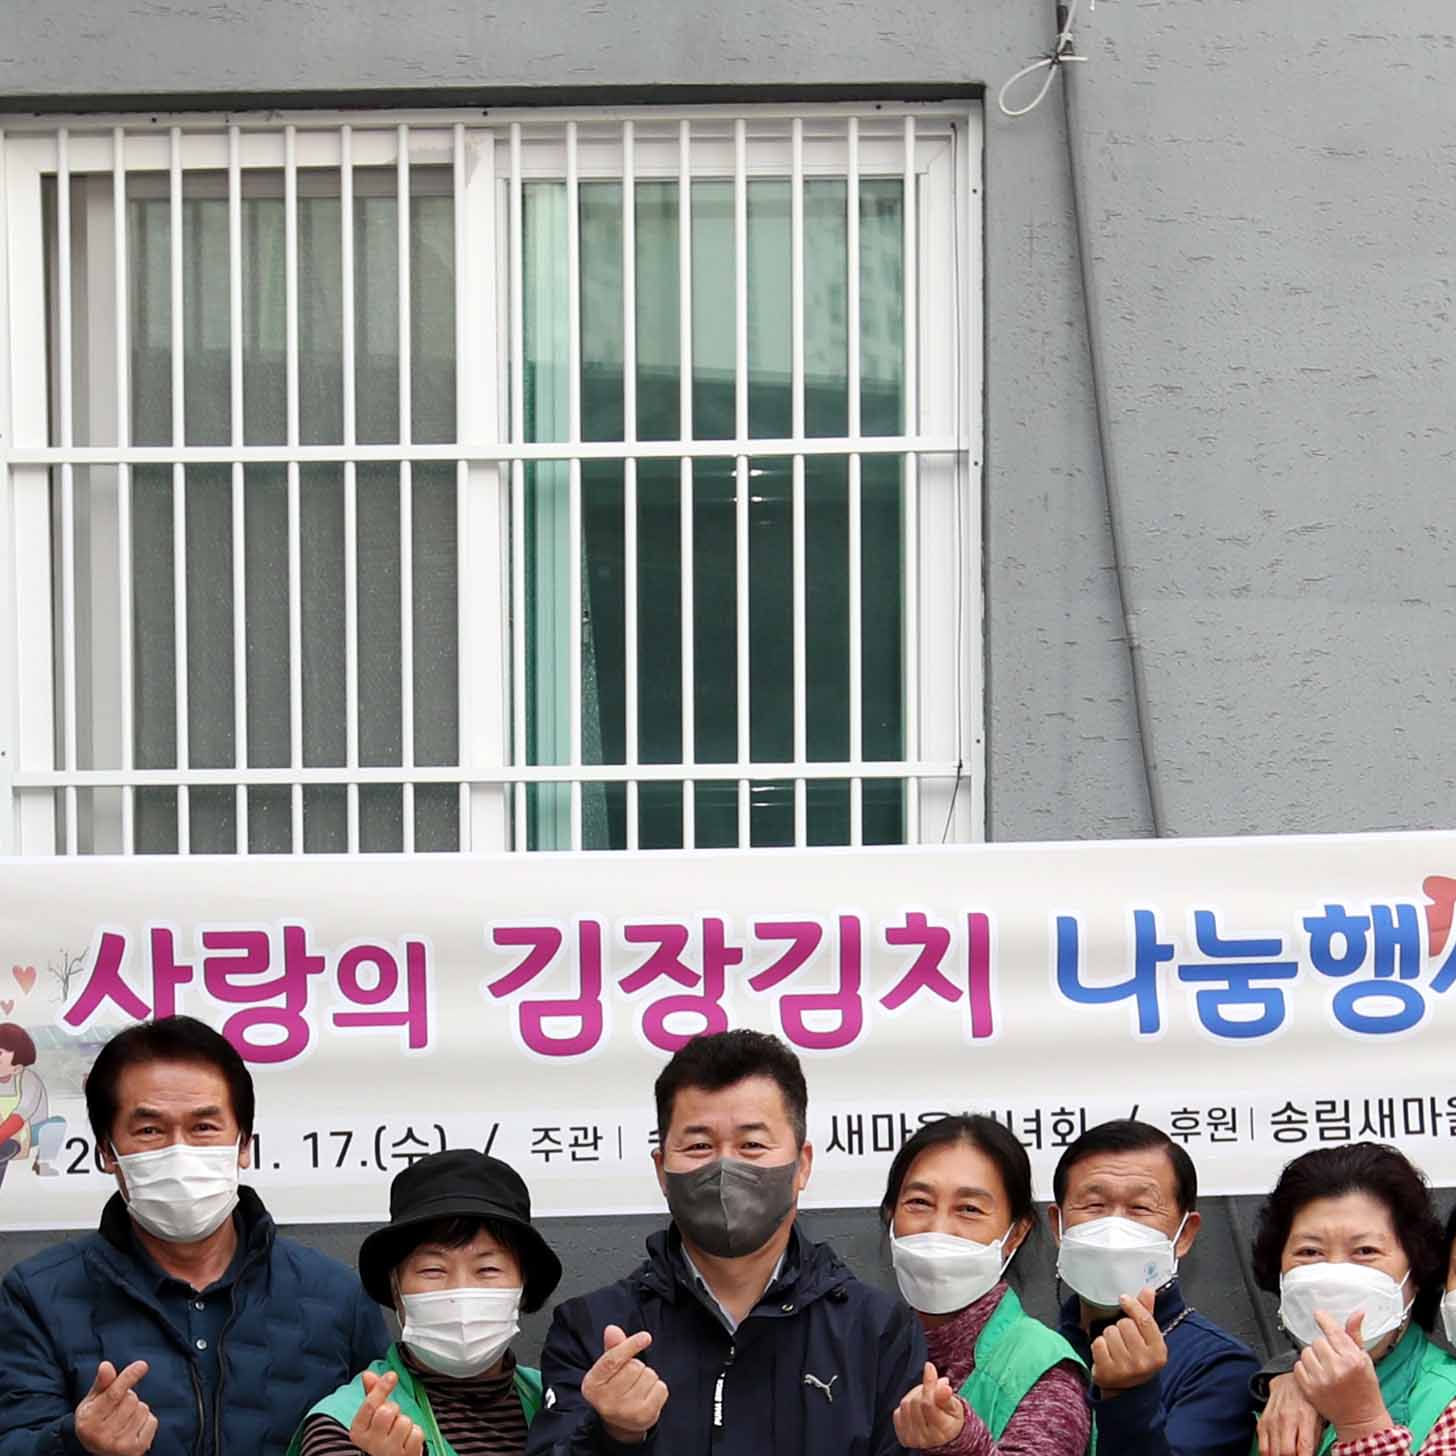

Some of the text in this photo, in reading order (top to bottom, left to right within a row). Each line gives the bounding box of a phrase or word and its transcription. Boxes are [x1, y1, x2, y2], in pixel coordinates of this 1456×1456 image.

[63, 925, 428, 1064] 사랑의
[486, 911, 994, 1057] 김장김치
[825, 1106, 1087, 1155] 새마녀회
